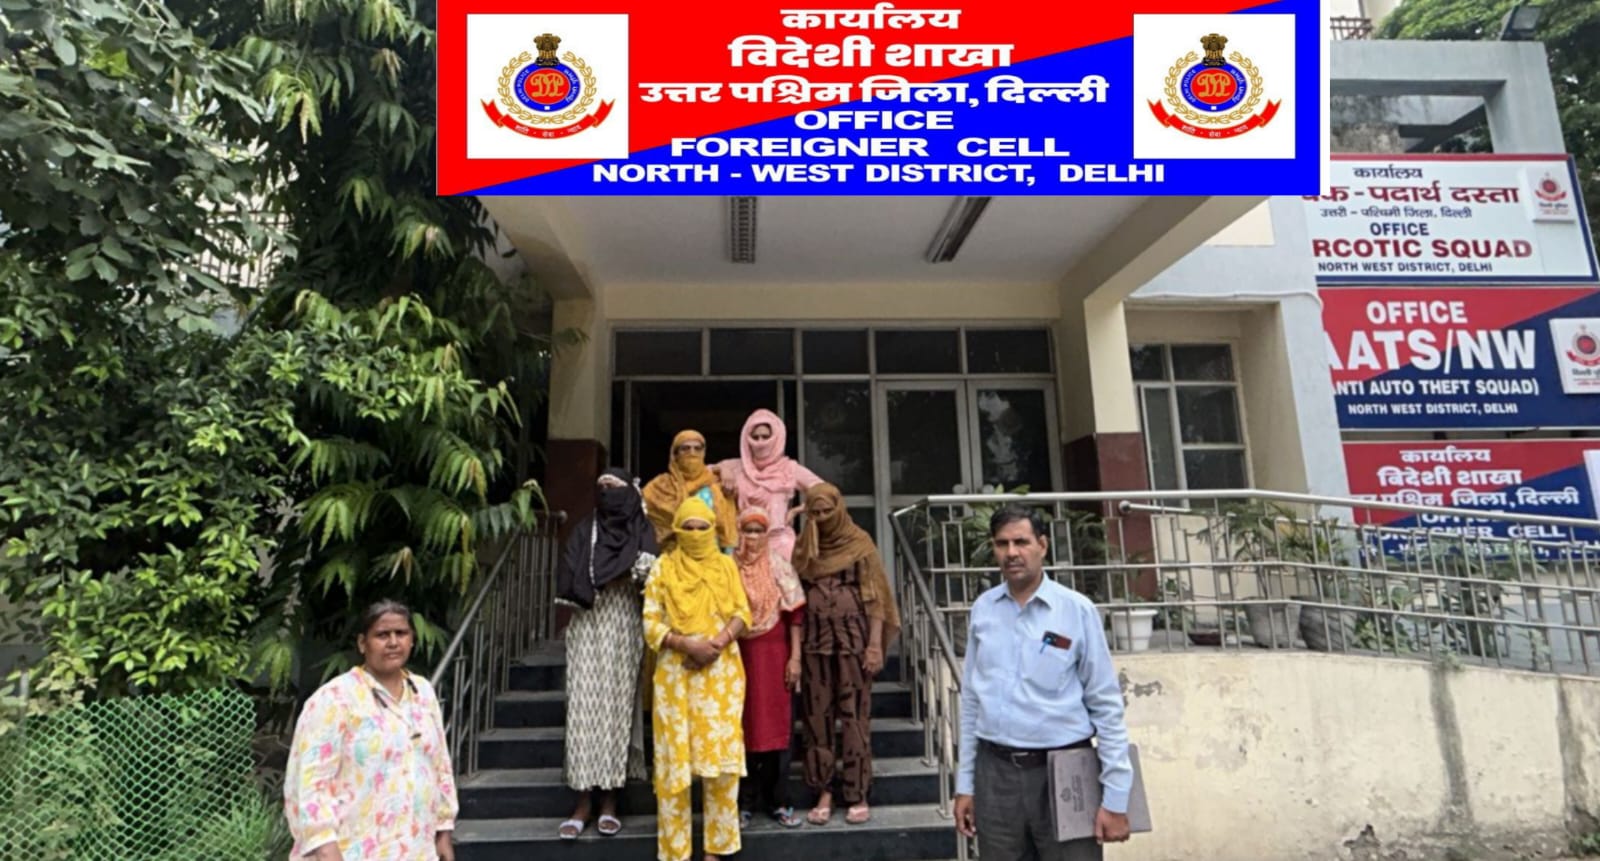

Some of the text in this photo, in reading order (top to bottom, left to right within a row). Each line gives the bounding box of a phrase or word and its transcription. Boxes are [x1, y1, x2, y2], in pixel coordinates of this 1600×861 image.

[1353, 164, 1423, 179] कार्यालय
[1449, 187, 1519, 203] दस्ता
[1370, 222, 1430, 236] OFFICE
[1313, 239, 1533, 259] RCOTIC SQUAD
[1318, 262, 1493, 274] NORTH WEST DISTRICT, DELHI
[1366, 300, 1468, 325] OFFICE
[1334, 379, 1540, 396] NTI AUTO THEFT SQUAD)
[1348, 403, 1518, 416] NORTH WEST DISTRICT, DELHI
[1399, 445, 1491, 463] कार्यालय
[1376, 465, 1522, 487] विदेशी शाखा
[1507, 524, 1567, 538] CELL
